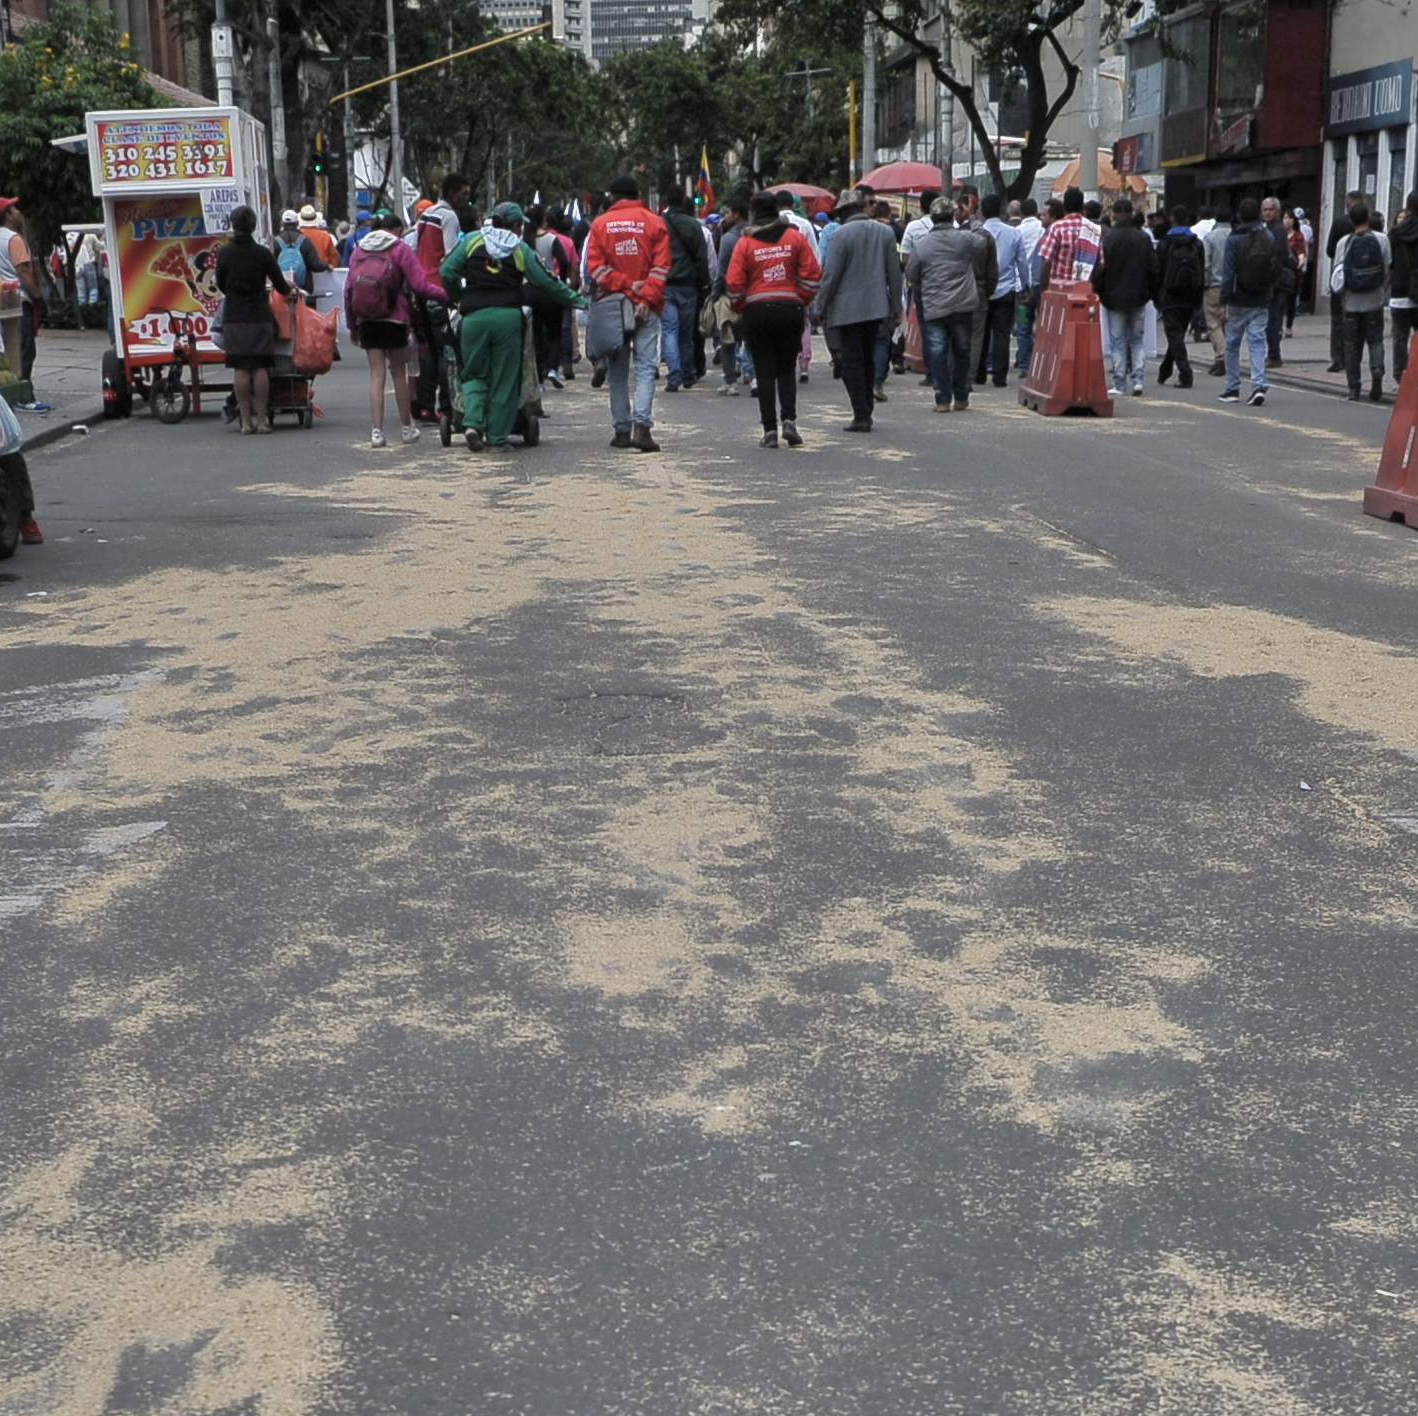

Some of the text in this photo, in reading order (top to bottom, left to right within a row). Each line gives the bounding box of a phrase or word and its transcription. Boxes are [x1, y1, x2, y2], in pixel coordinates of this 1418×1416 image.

[1374, 74, 1402, 116] UOMO
[105, 121, 222, 134] ATENDEMOS TODA
[103, 131, 225, 144] CLASE DE EVENTOS
[104, 147, 138, 163] 310
[143, 146, 177, 161] 245
[105, 160, 228, 180] 320 431 1617
[210, 189, 239, 203] AREPAS
[131, 216, 223, 241] PIZZ
[140, 316, 208, 338] $1.000
